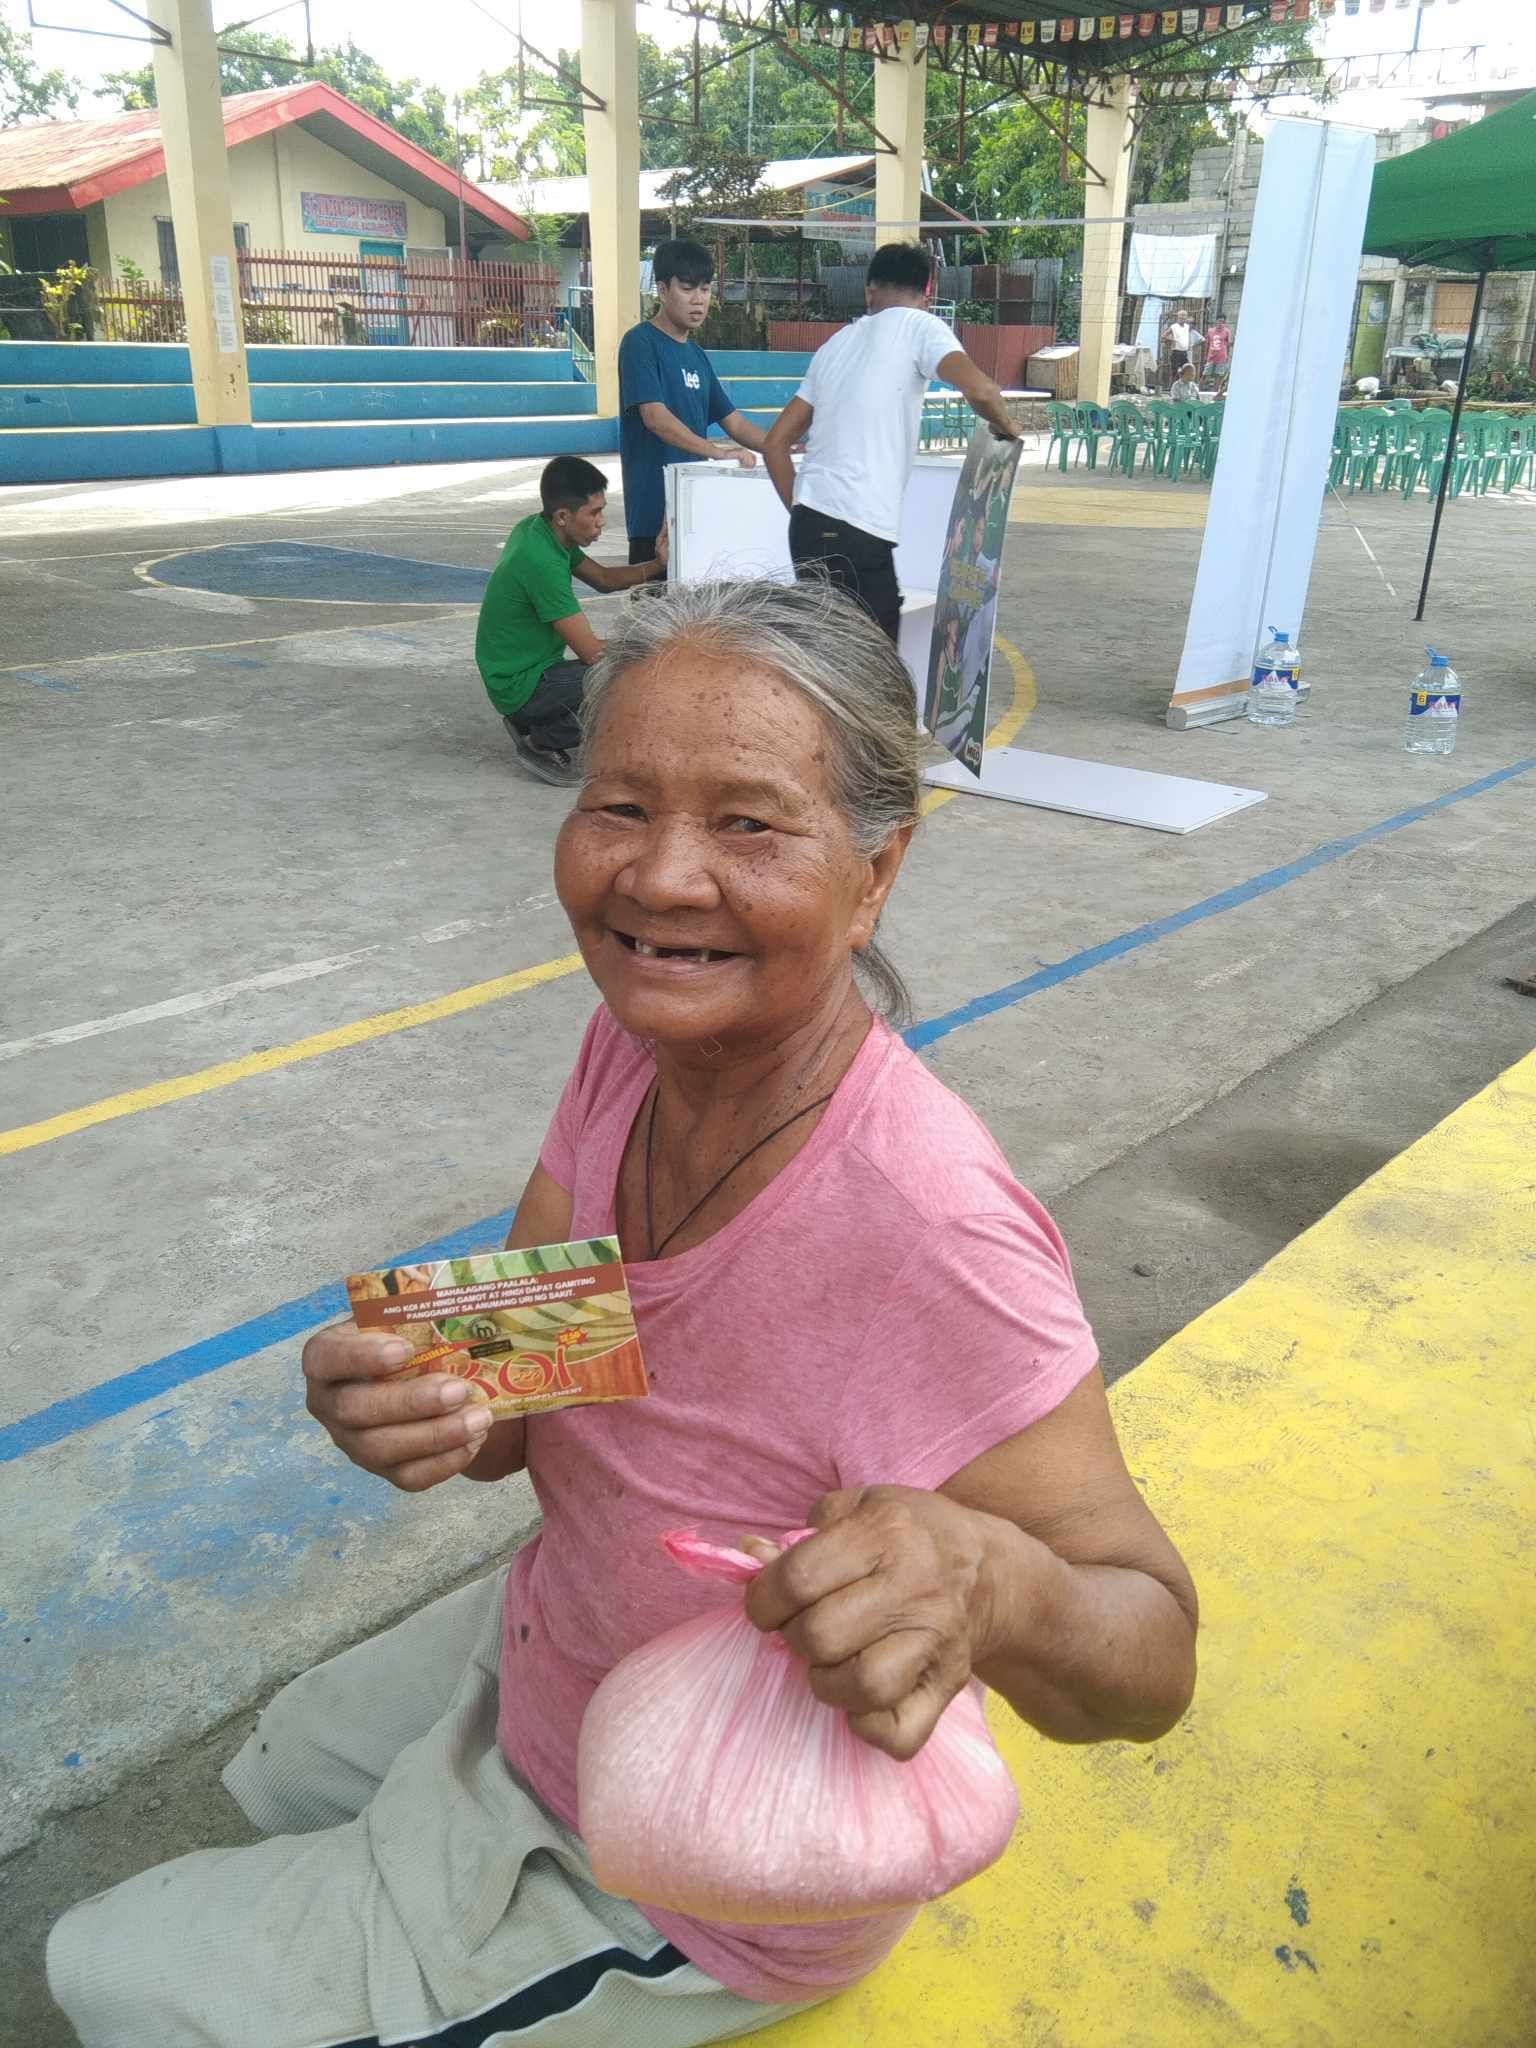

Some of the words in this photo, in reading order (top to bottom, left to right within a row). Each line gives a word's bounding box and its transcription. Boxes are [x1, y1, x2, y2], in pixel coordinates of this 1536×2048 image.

[681, 368, 700, 389] lee
[384, 1305, 402, 1314] ANG
[403, 1303, 418, 1312] KOI
[420, 1302, 431, 1310] AY
[432, 1299, 455, 1308] HINDI
[457, 1294, 486, 1305] GAMOT
[488, 1291, 500, 1300] AT
[502, 1288, 525, 1298] HINDI
[526, 1283, 553, 1294] DAPAT
[555, 1276, 596, 1290] GAMITING
[436, 1283, 496, 1298] MAHALAGANG
[497, 1278, 539, 1289] PAALALA:
[406, 1306, 460, 1320] PANGGAMOT
[461, 1304, 473, 1313] SA
[475, 1297, 517, 1310] ANUMANG
[519, 1295, 533, 1305] URI
[535, 1293, 547, 1302] NG
[549, 1289, 576, 1300] SAKIT.
[447, 1344, 575, 1402] KOI
